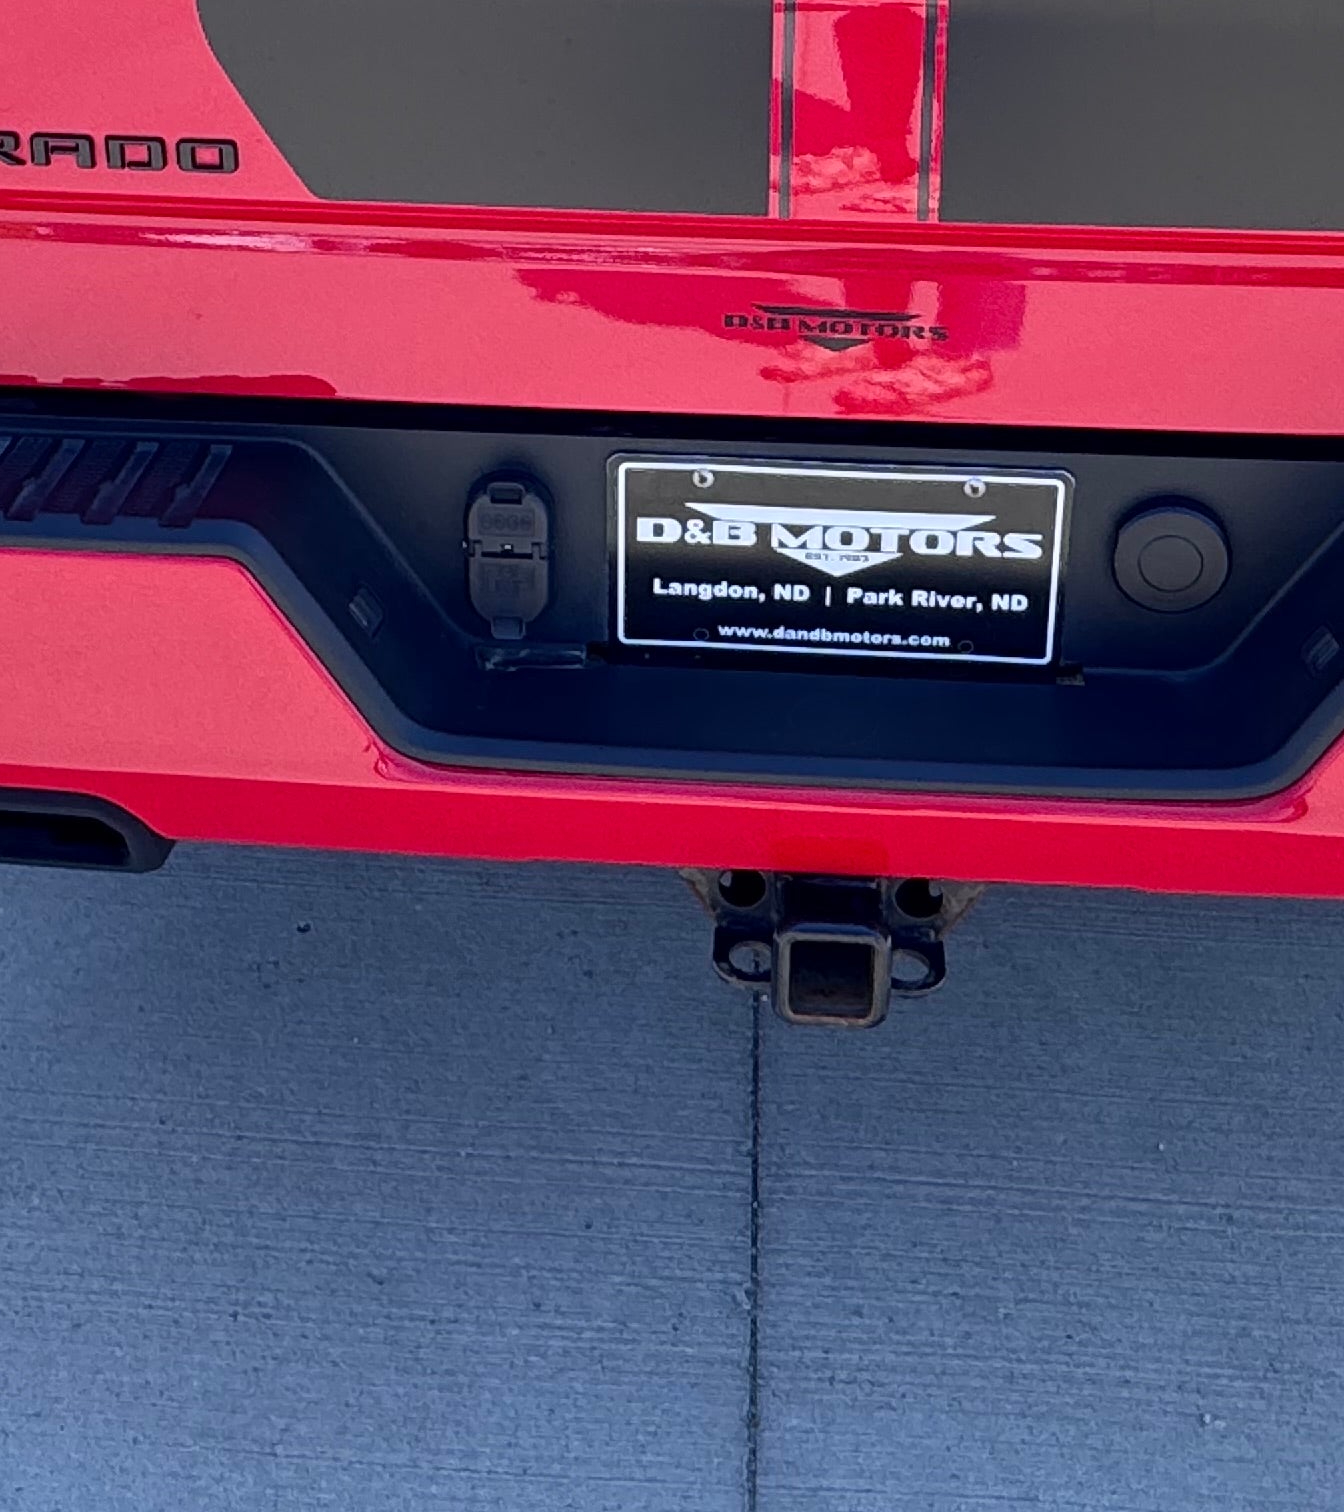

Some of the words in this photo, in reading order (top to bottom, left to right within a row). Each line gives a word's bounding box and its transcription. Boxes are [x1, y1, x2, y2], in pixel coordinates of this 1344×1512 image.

[798, 320, 949, 341] MOTORS
[636, 516, 758, 547] D&B
[770, 522, 1043, 559] MOTORS
[652, 577, 766, 603] Langdon,
[773, 584, 811, 602] ND
[846, 587, 904, 606] Park
[911, 590, 984, 613] River,
[991, 594, 1029, 611] ND
[717, 624, 951, 648] www.dandbmotors.com
